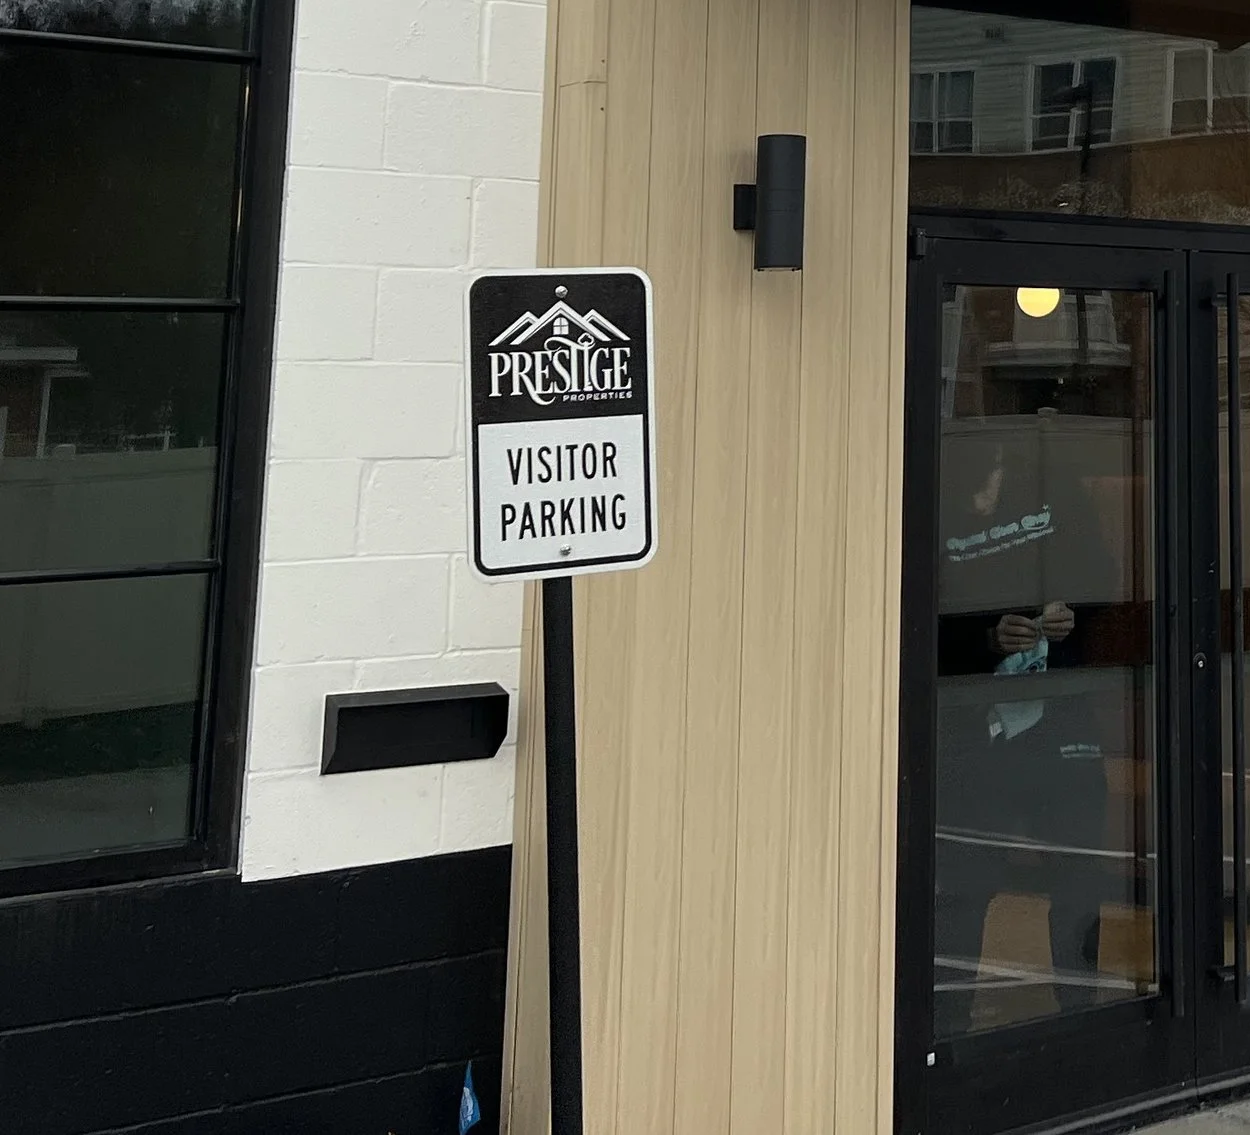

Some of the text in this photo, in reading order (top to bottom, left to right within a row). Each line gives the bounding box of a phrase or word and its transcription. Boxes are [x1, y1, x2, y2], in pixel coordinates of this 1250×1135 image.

[488, 333, 632, 405] PRESTIGE
[562, 391, 633, 402] PROPERTIES
[507, 441, 617, 485] VISITOR
[501, 493, 627, 542] PARKING
